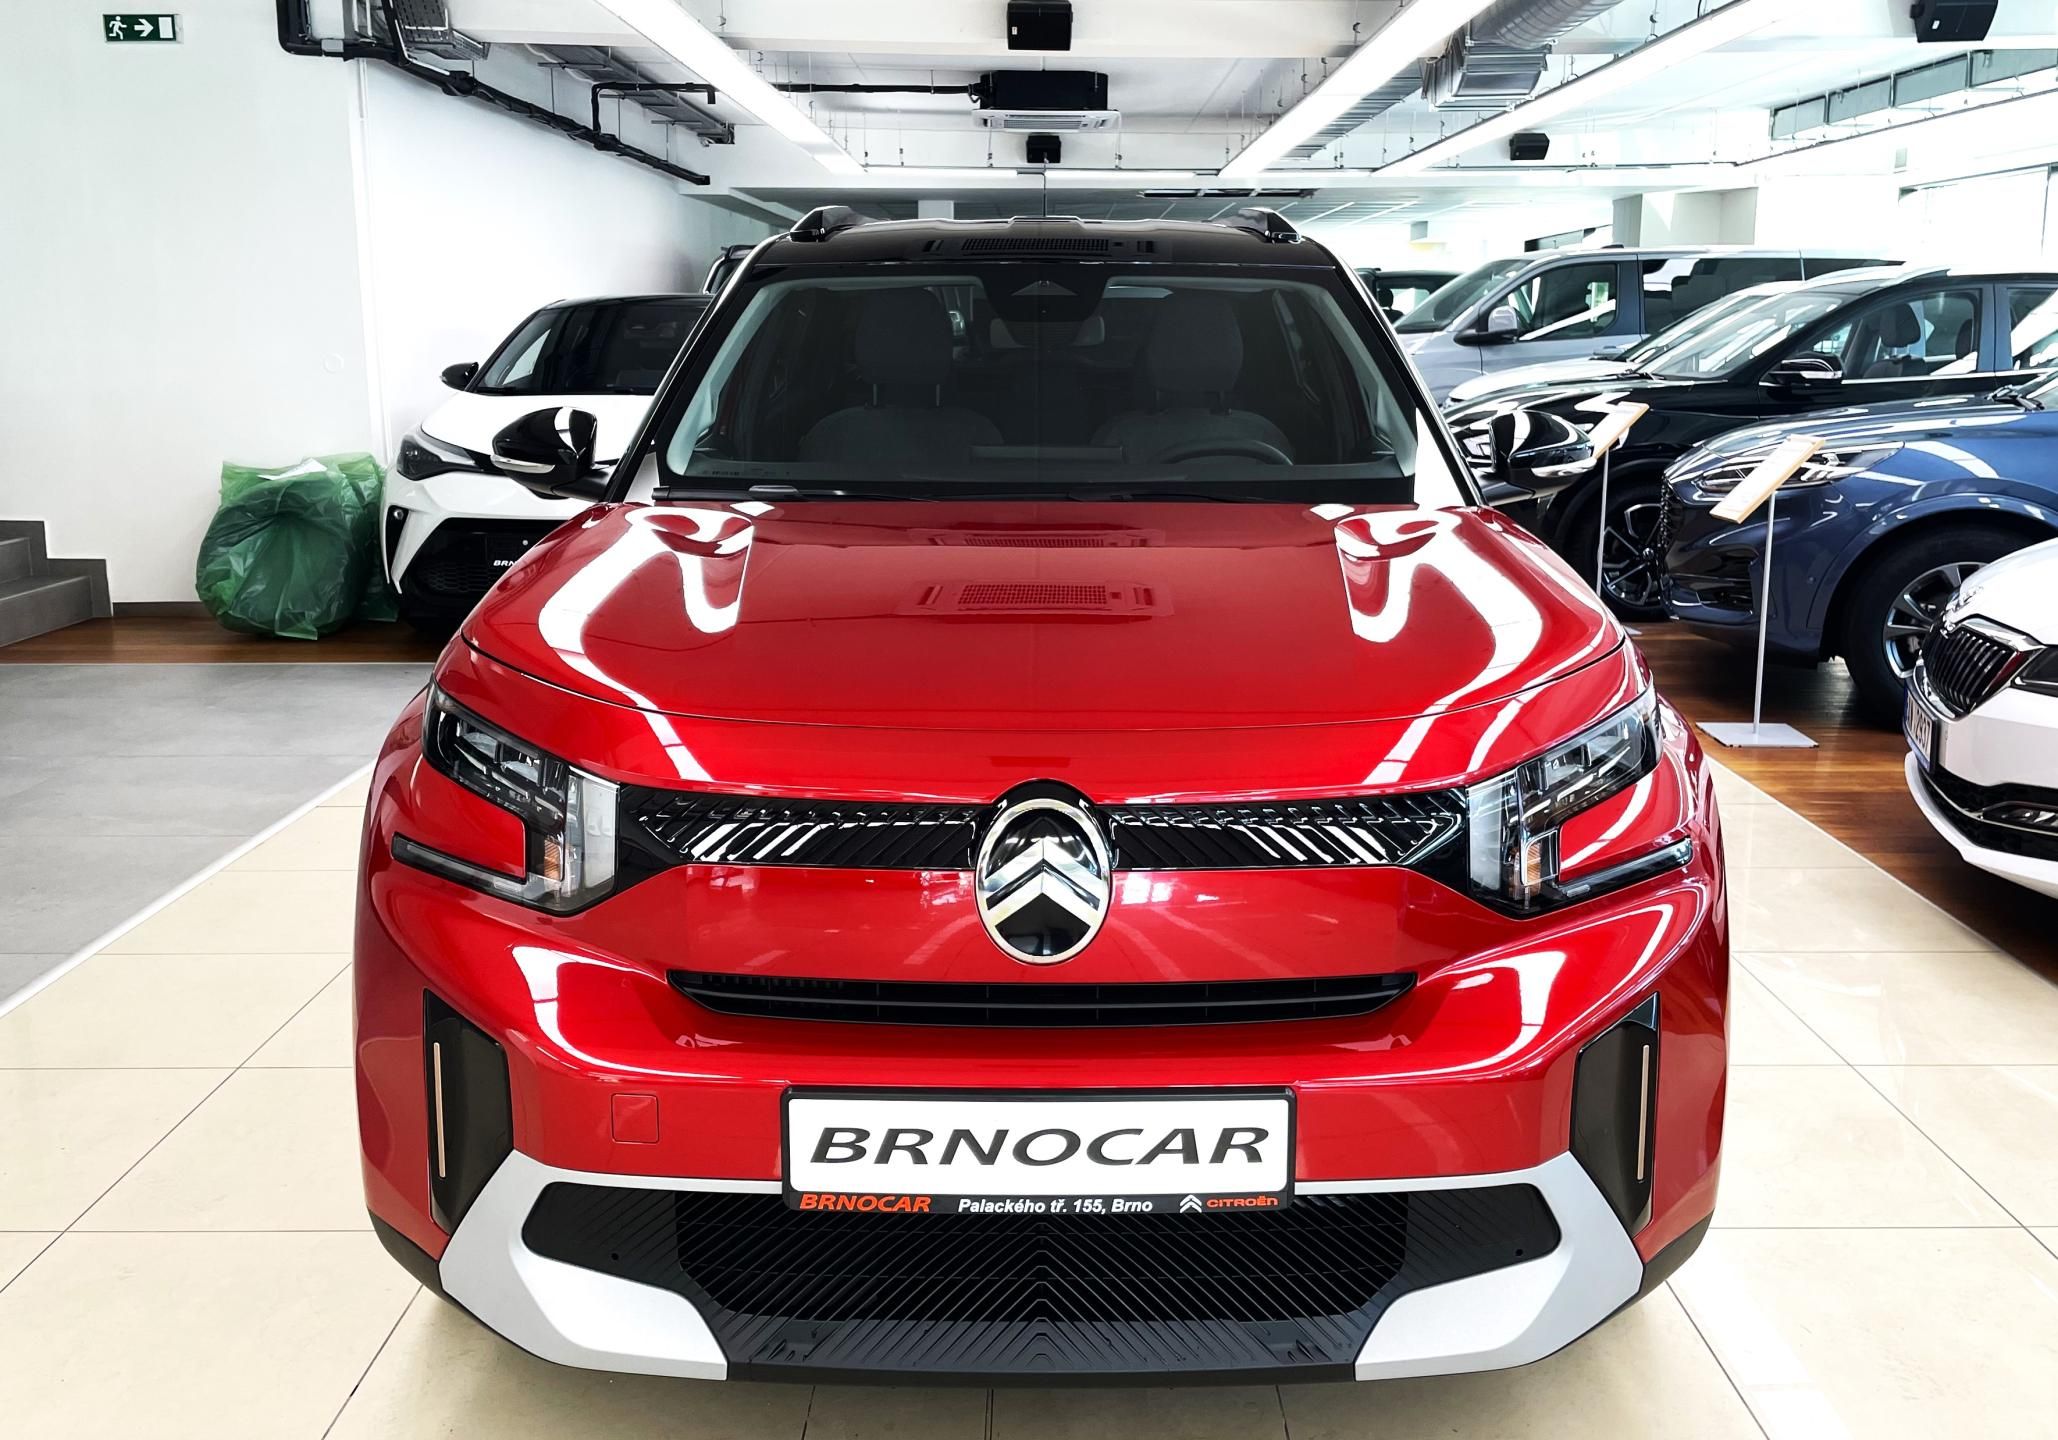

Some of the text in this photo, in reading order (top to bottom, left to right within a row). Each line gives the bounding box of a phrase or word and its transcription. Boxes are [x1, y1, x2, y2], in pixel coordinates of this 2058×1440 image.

[809, 1126, 1270, 1167] BRNOCAR
[799, 1193, 932, 1213] BRNOCAR
[957, 1198, 1154, 1215] Palackého tř. 155, Brno
